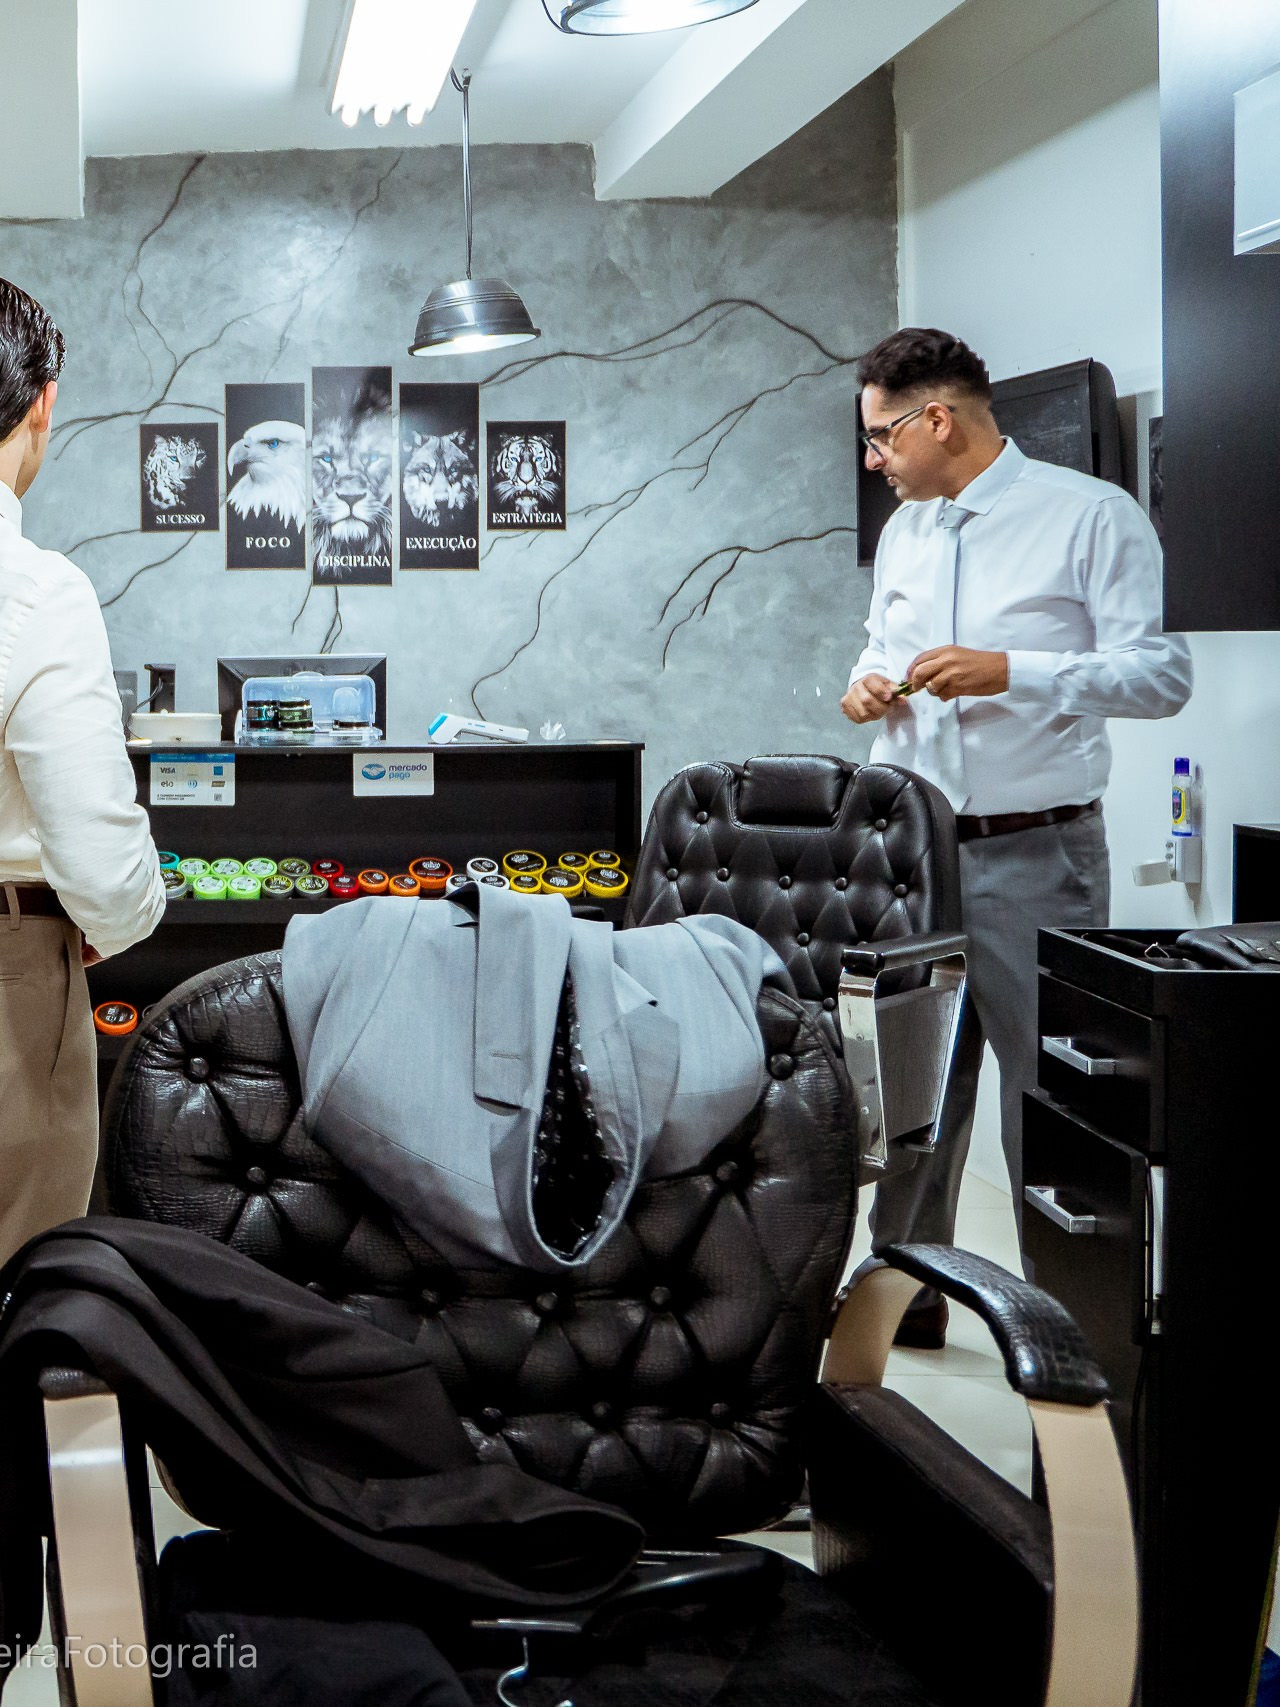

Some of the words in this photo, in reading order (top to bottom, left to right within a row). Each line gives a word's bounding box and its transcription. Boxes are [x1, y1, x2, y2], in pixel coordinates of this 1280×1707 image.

[155, 513, 206, 525] SUCESSO
[245, 536, 291, 549] FOCO
[405, 535, 477, 551] EXECUÇÃO
[319, 555, 391, 567] DISCIPLINA
[388, 763, 428, 772] mercado
[388, 772, 411, 780] pago
